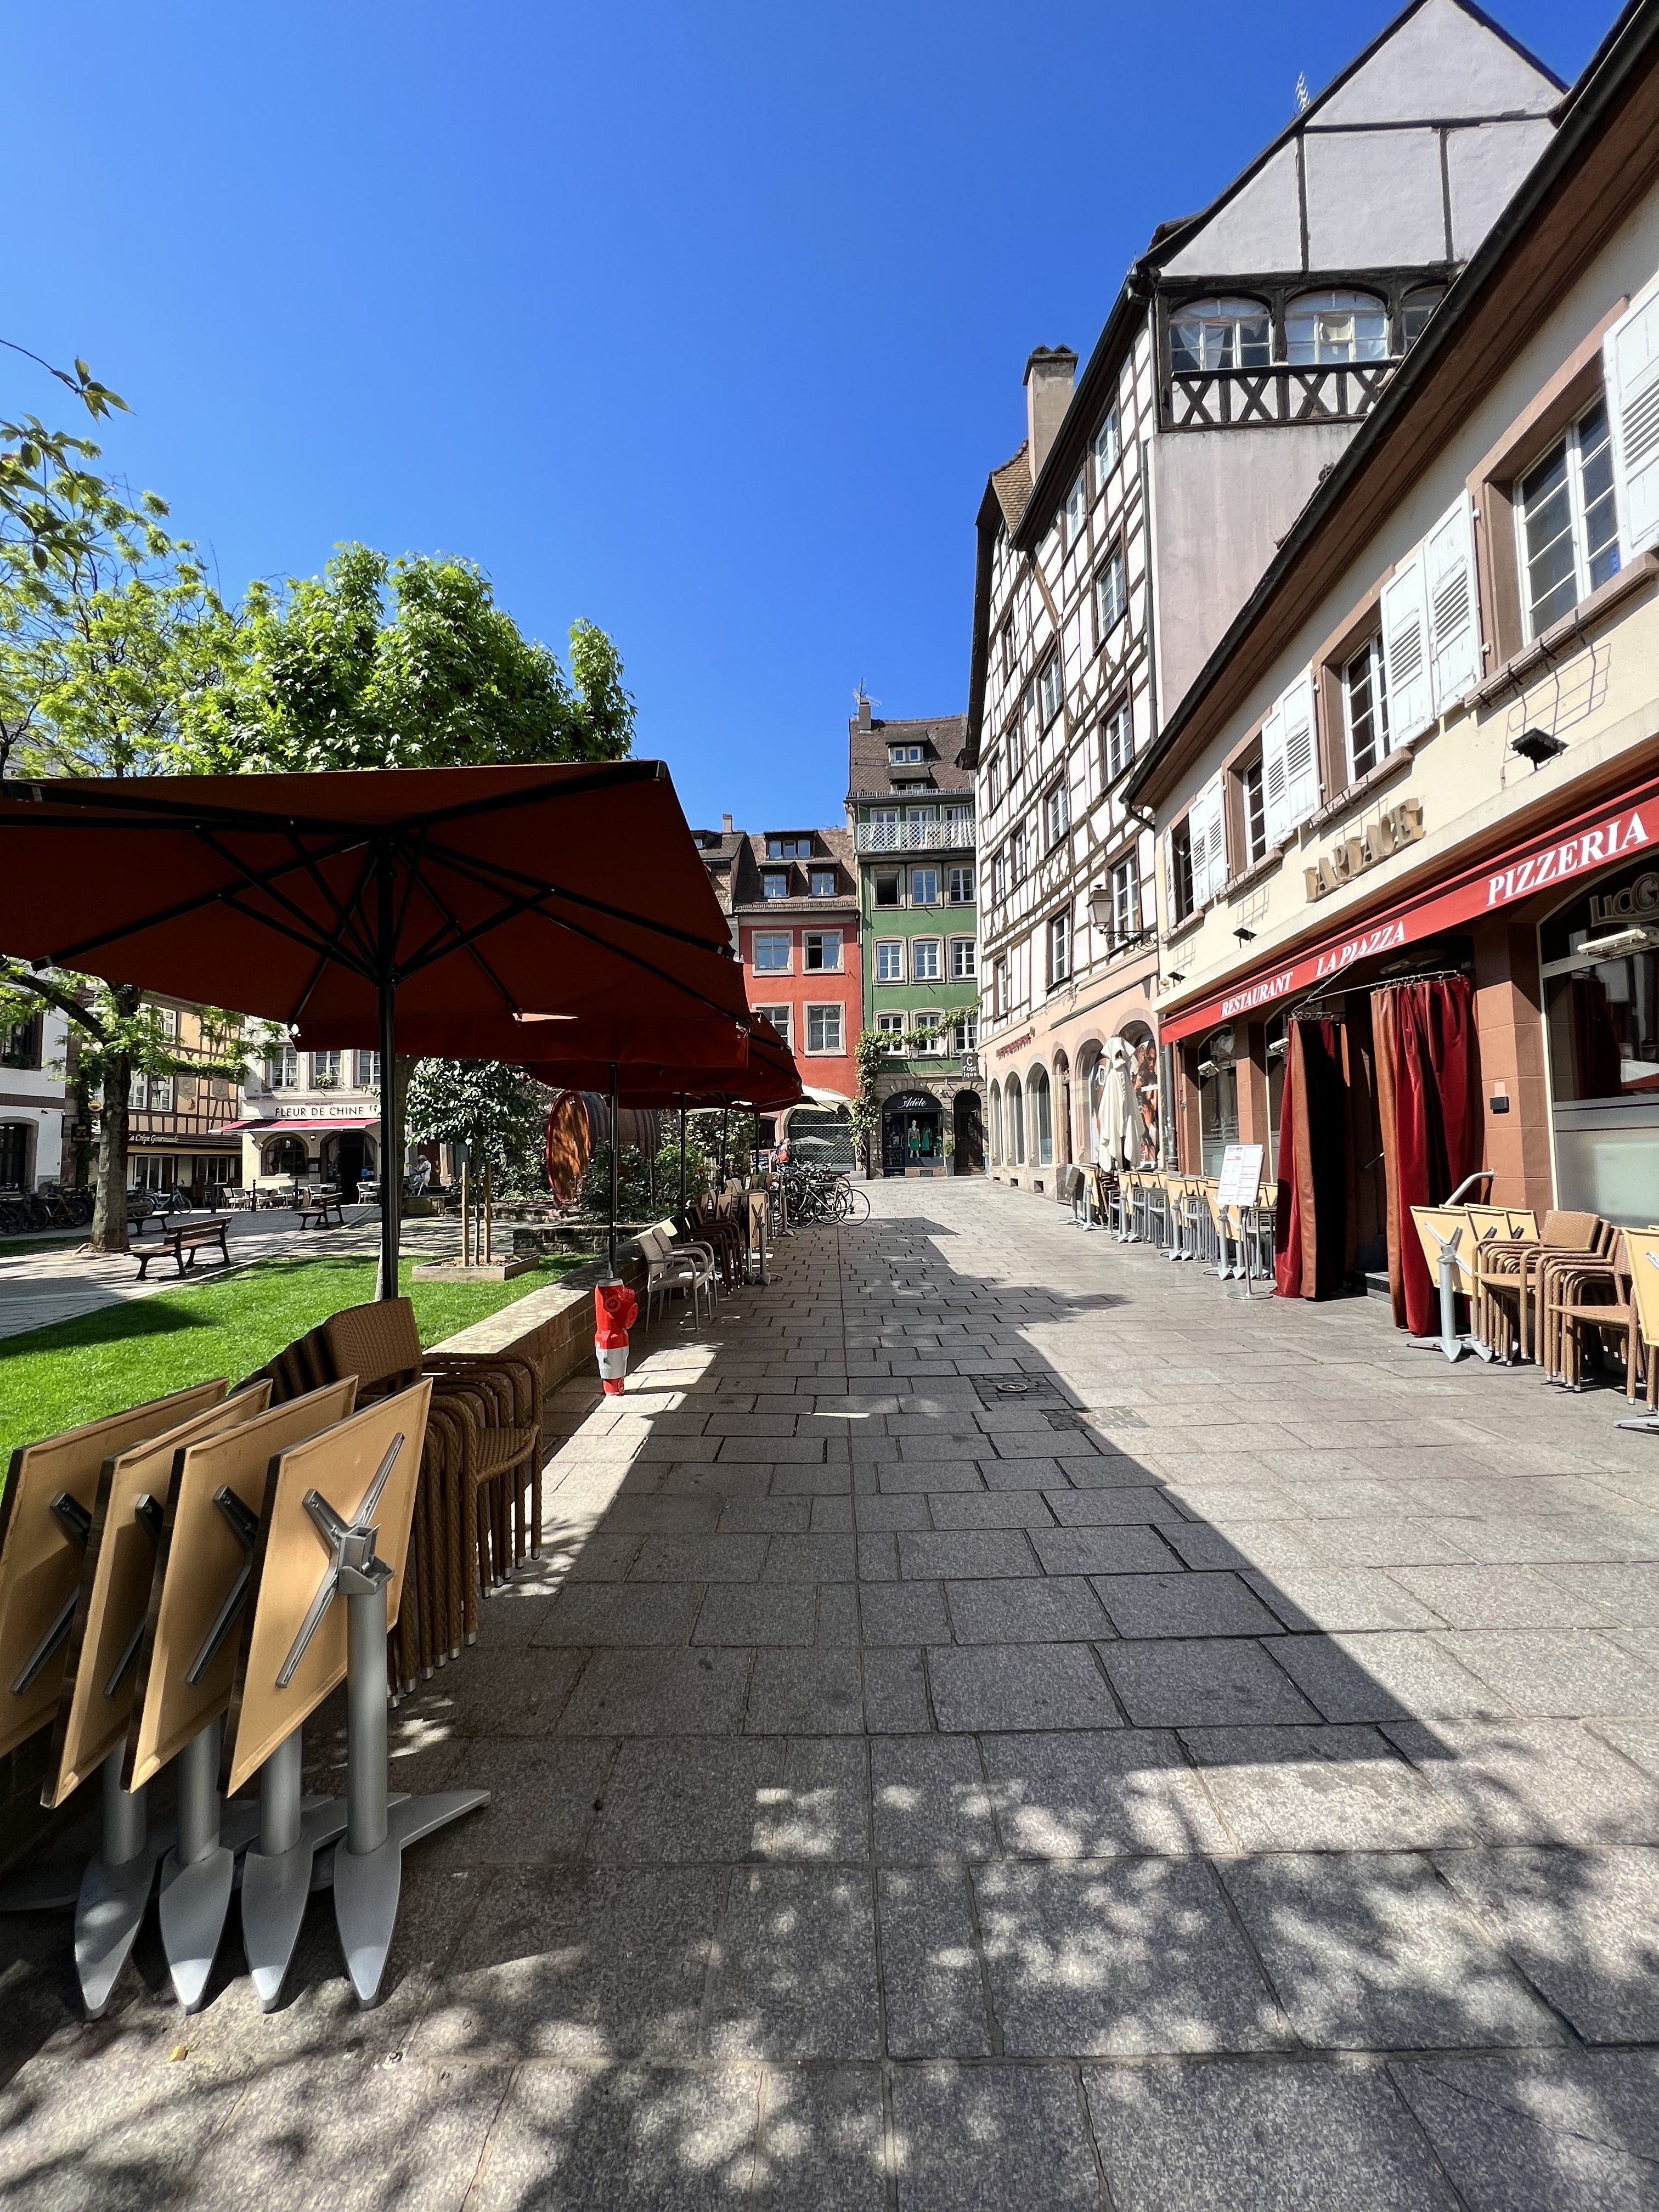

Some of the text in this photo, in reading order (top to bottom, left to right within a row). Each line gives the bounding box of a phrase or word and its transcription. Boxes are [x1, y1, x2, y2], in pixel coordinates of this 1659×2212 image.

[1486, 811, 1649, 907] PIZZERIA
[1315, 921, 1405, 978] LA PIAZZA
[1220, 970, 1294, 1019] RESTAURANT
[966, 1056, 973, 1066] C
[275, 1108, 306, 1116] FLEUR
[311, 1107, 325, 1116] DE
[329, 1107, 364, 1115] CHINE
